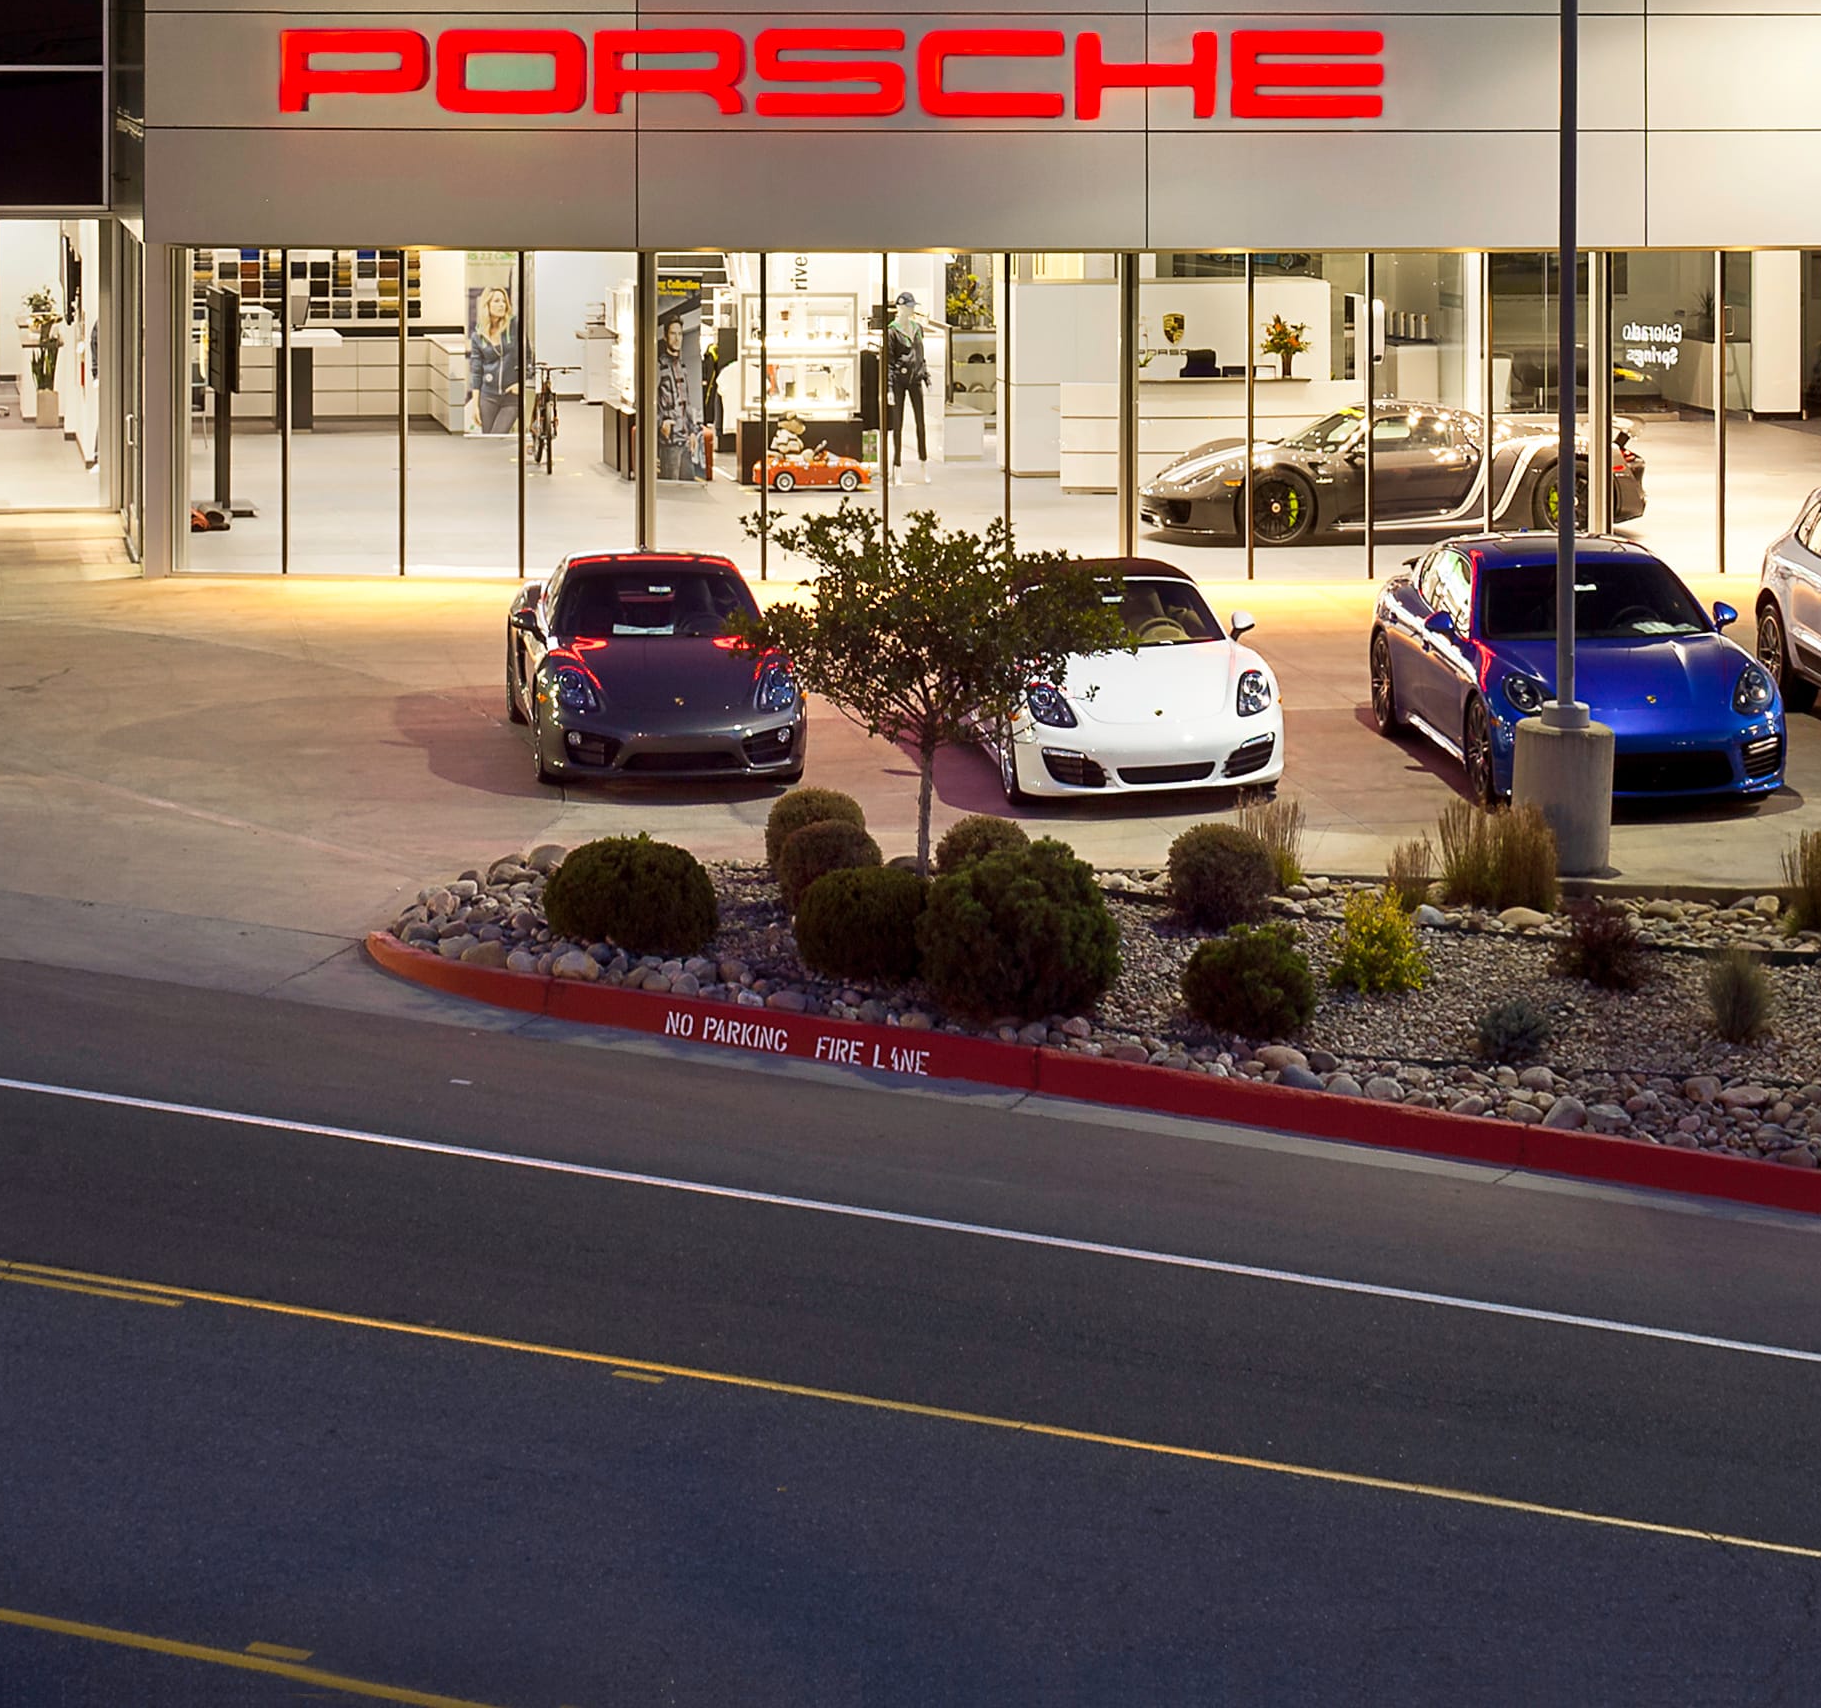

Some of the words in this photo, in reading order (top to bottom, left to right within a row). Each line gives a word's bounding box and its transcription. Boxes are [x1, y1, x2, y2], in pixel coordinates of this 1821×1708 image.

[280, 28, 1384, 121] PORSCHE
[790, 256, 808, 290] rive
[665, 1011, 694, 1037] NO
[702, 1016, 788, 1052] PARKING
[815, 1036, 864, 1066] FIRE
[872, 1043, 930, 1076] LANE
